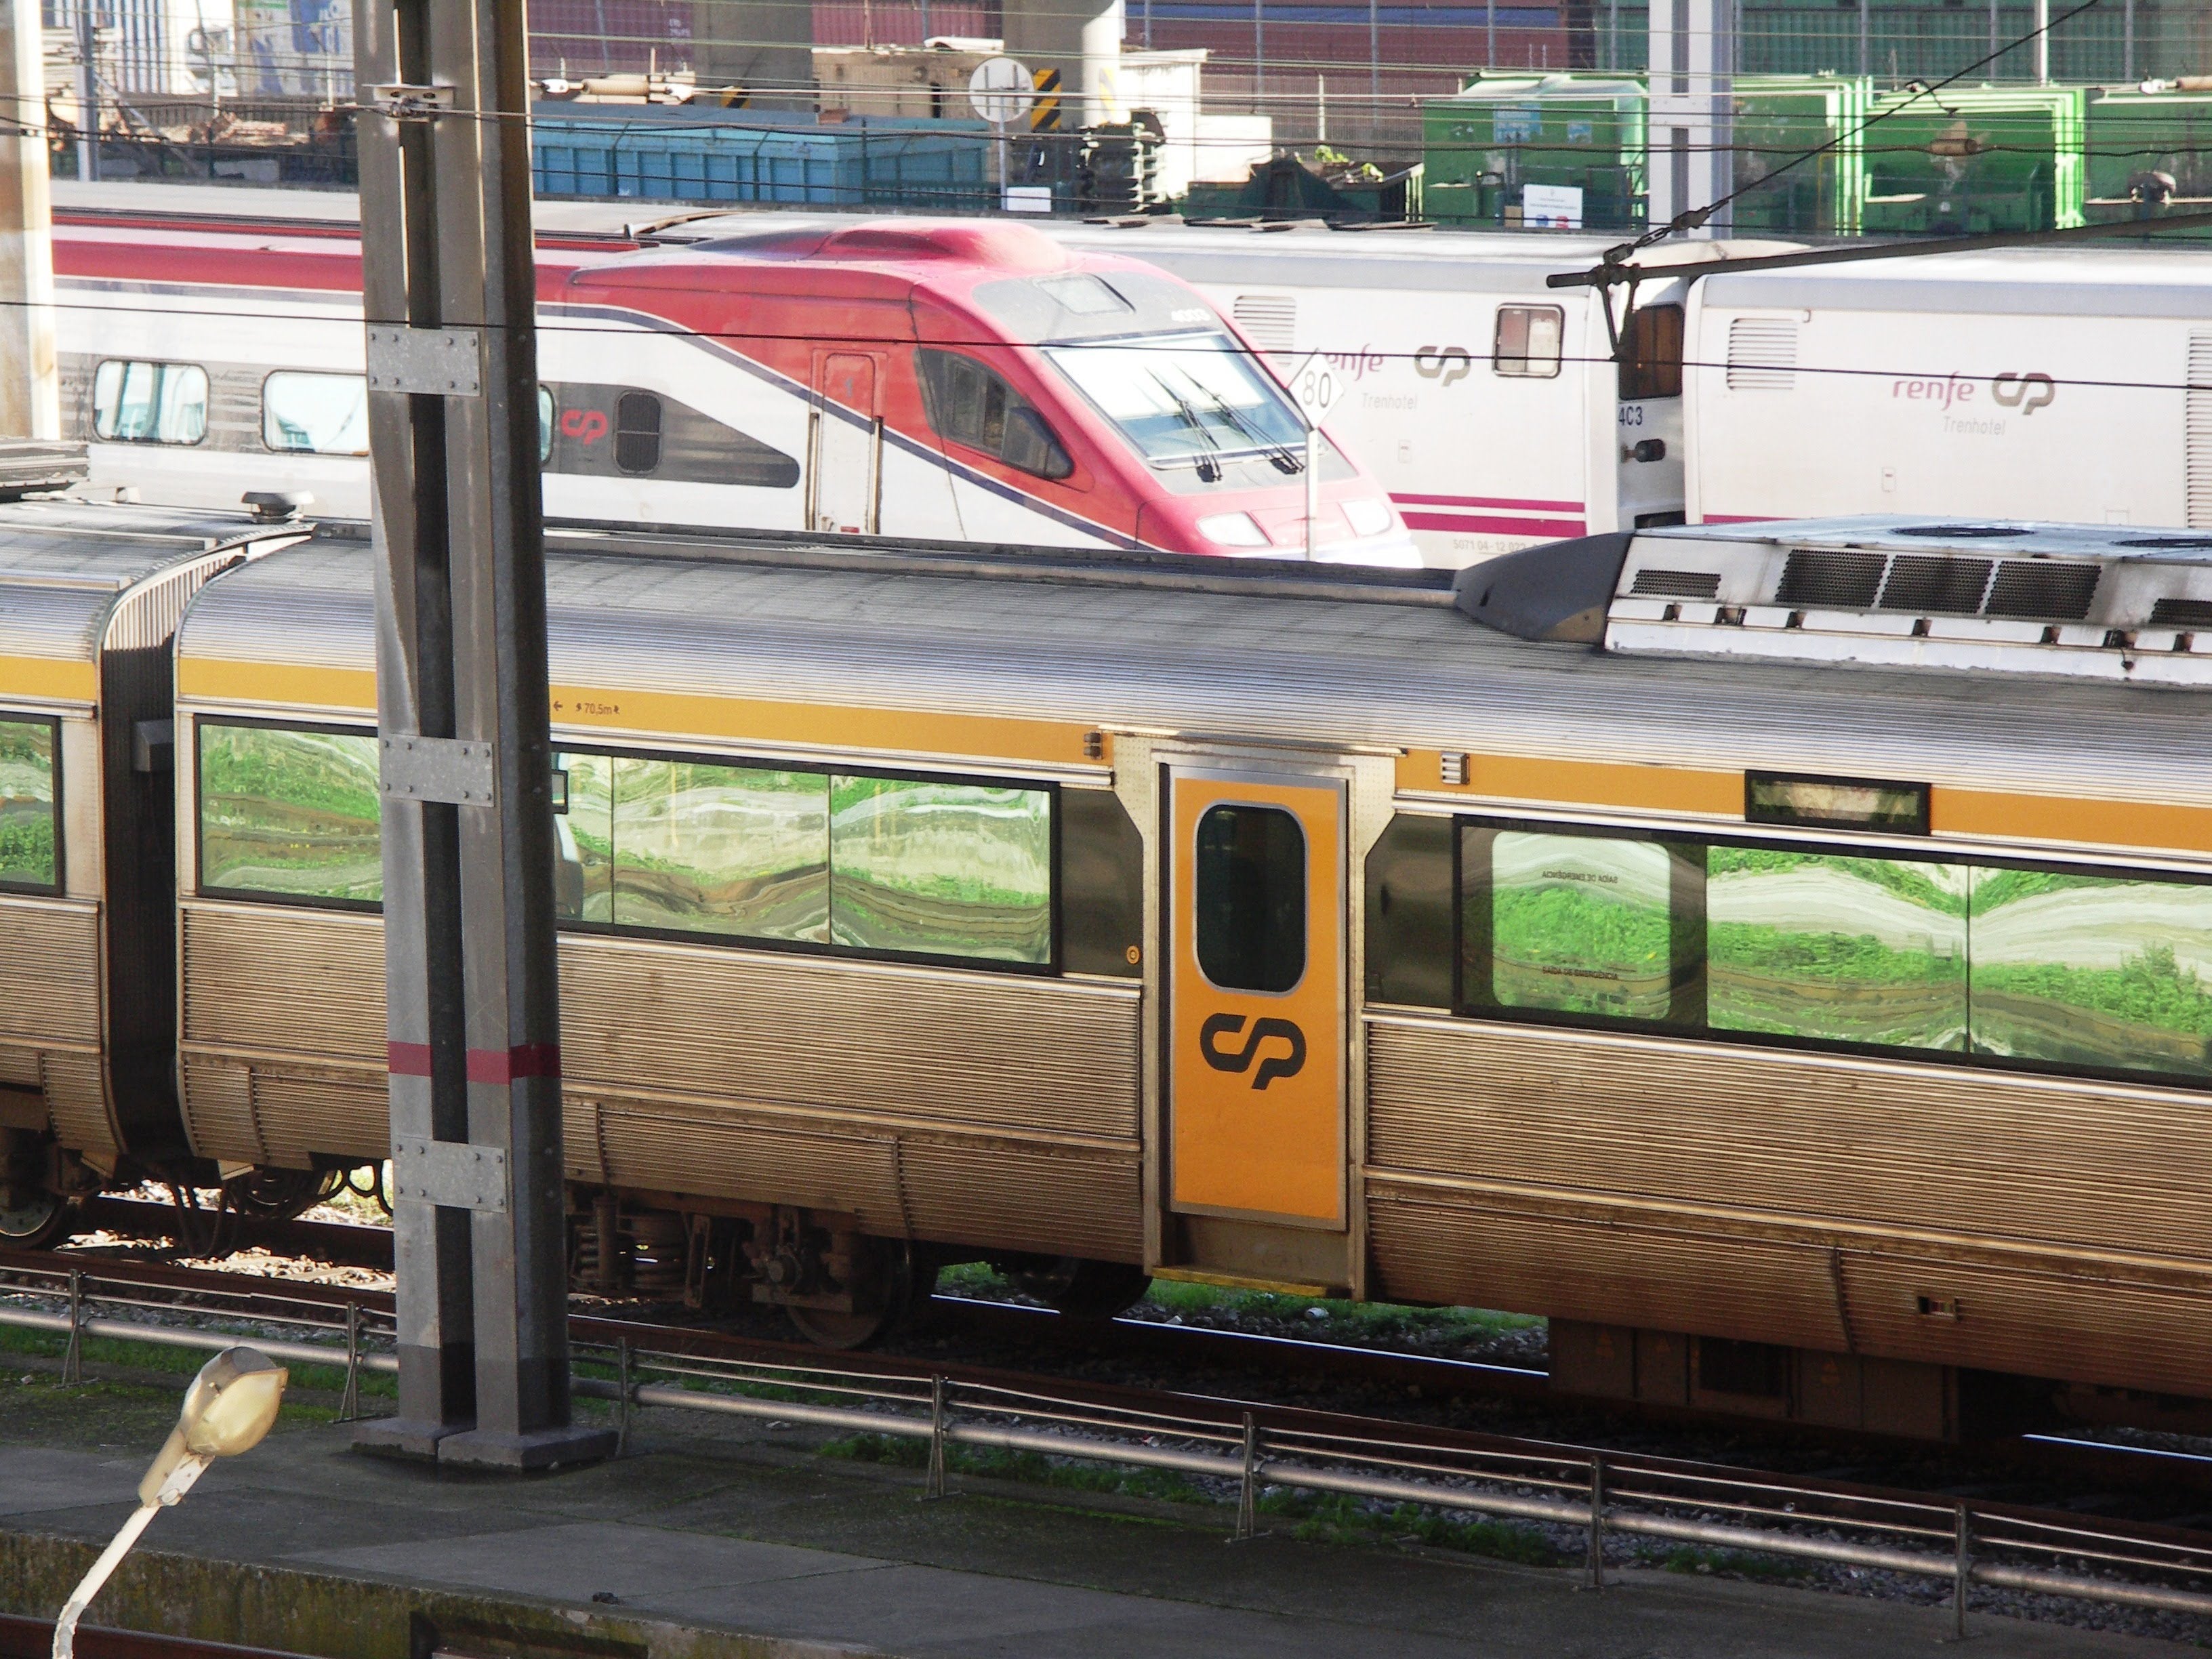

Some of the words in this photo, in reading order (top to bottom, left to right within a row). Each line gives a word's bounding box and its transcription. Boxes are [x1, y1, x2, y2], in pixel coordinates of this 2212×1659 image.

[1325, 344, 1384, 382] enfe
[1303, 371, 1332, 408] 80
[1361, 392, 1418, 409] Trenhotel
[1893, 371, 1975, 411] renfe
[1618, 406, 1643, 426] 4C3
[1942, 415, 2006, 435] Trenhotel
